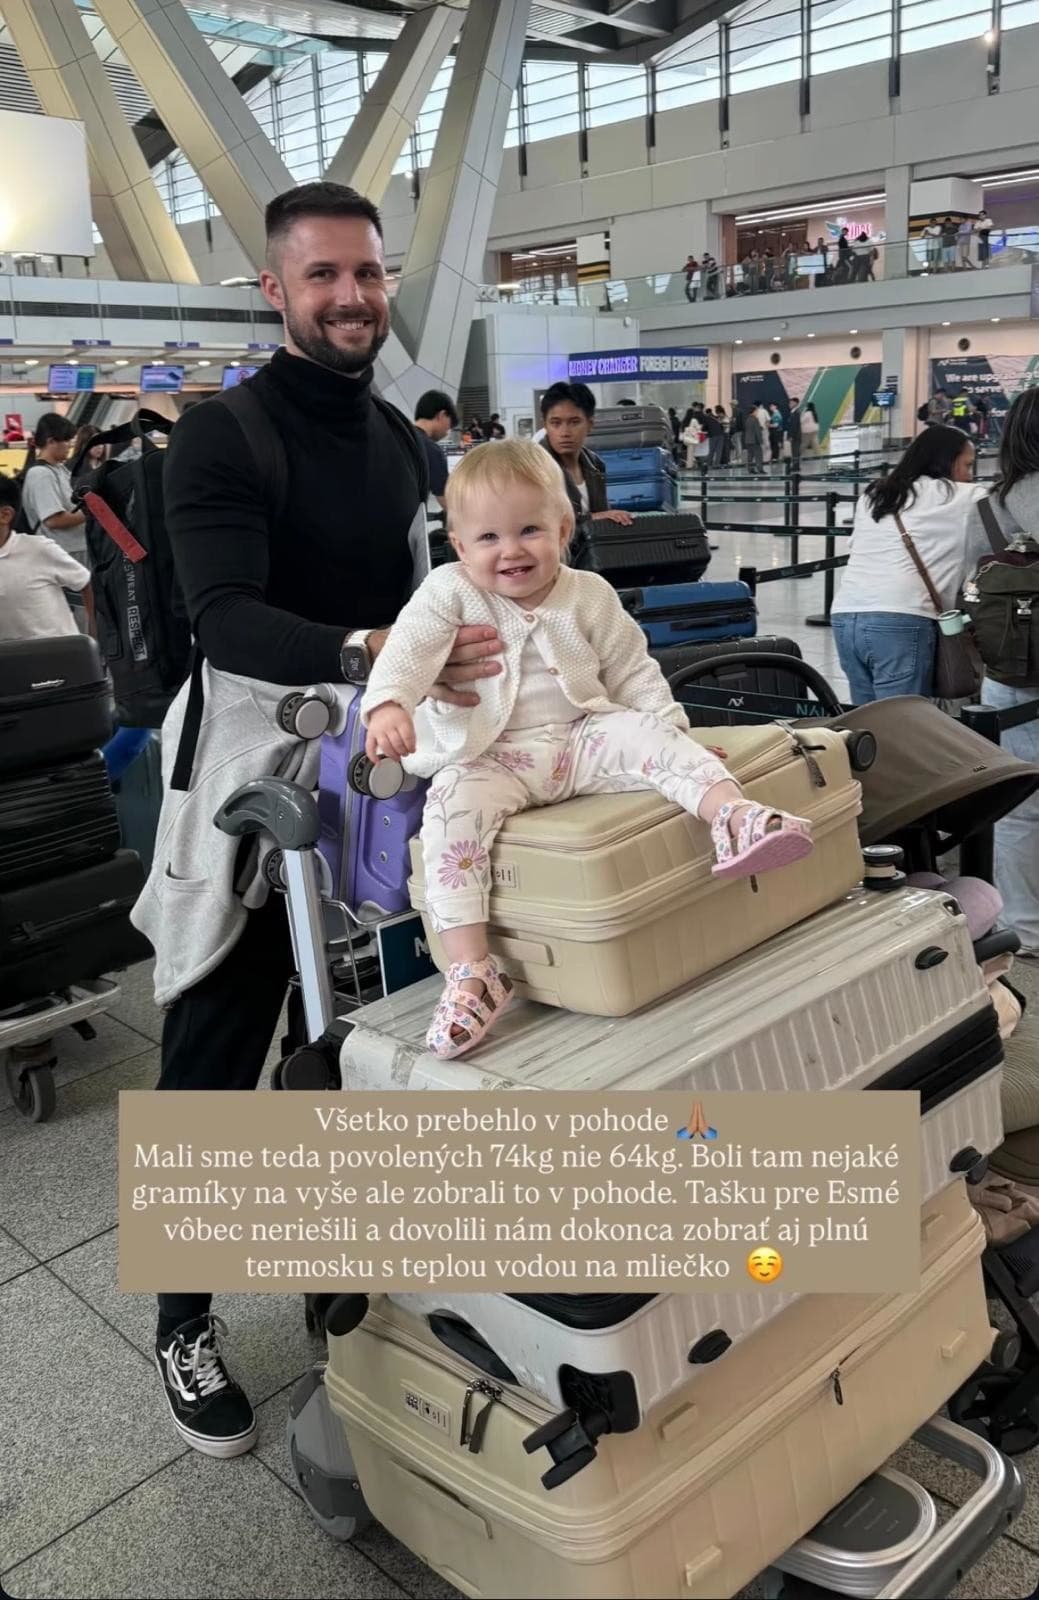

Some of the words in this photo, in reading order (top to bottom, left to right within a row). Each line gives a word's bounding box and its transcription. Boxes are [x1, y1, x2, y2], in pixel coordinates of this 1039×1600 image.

[598, 356, 638, 374] CHANGER
[945, 373, 961, 382] We
[962, 374, 979, 382] are
